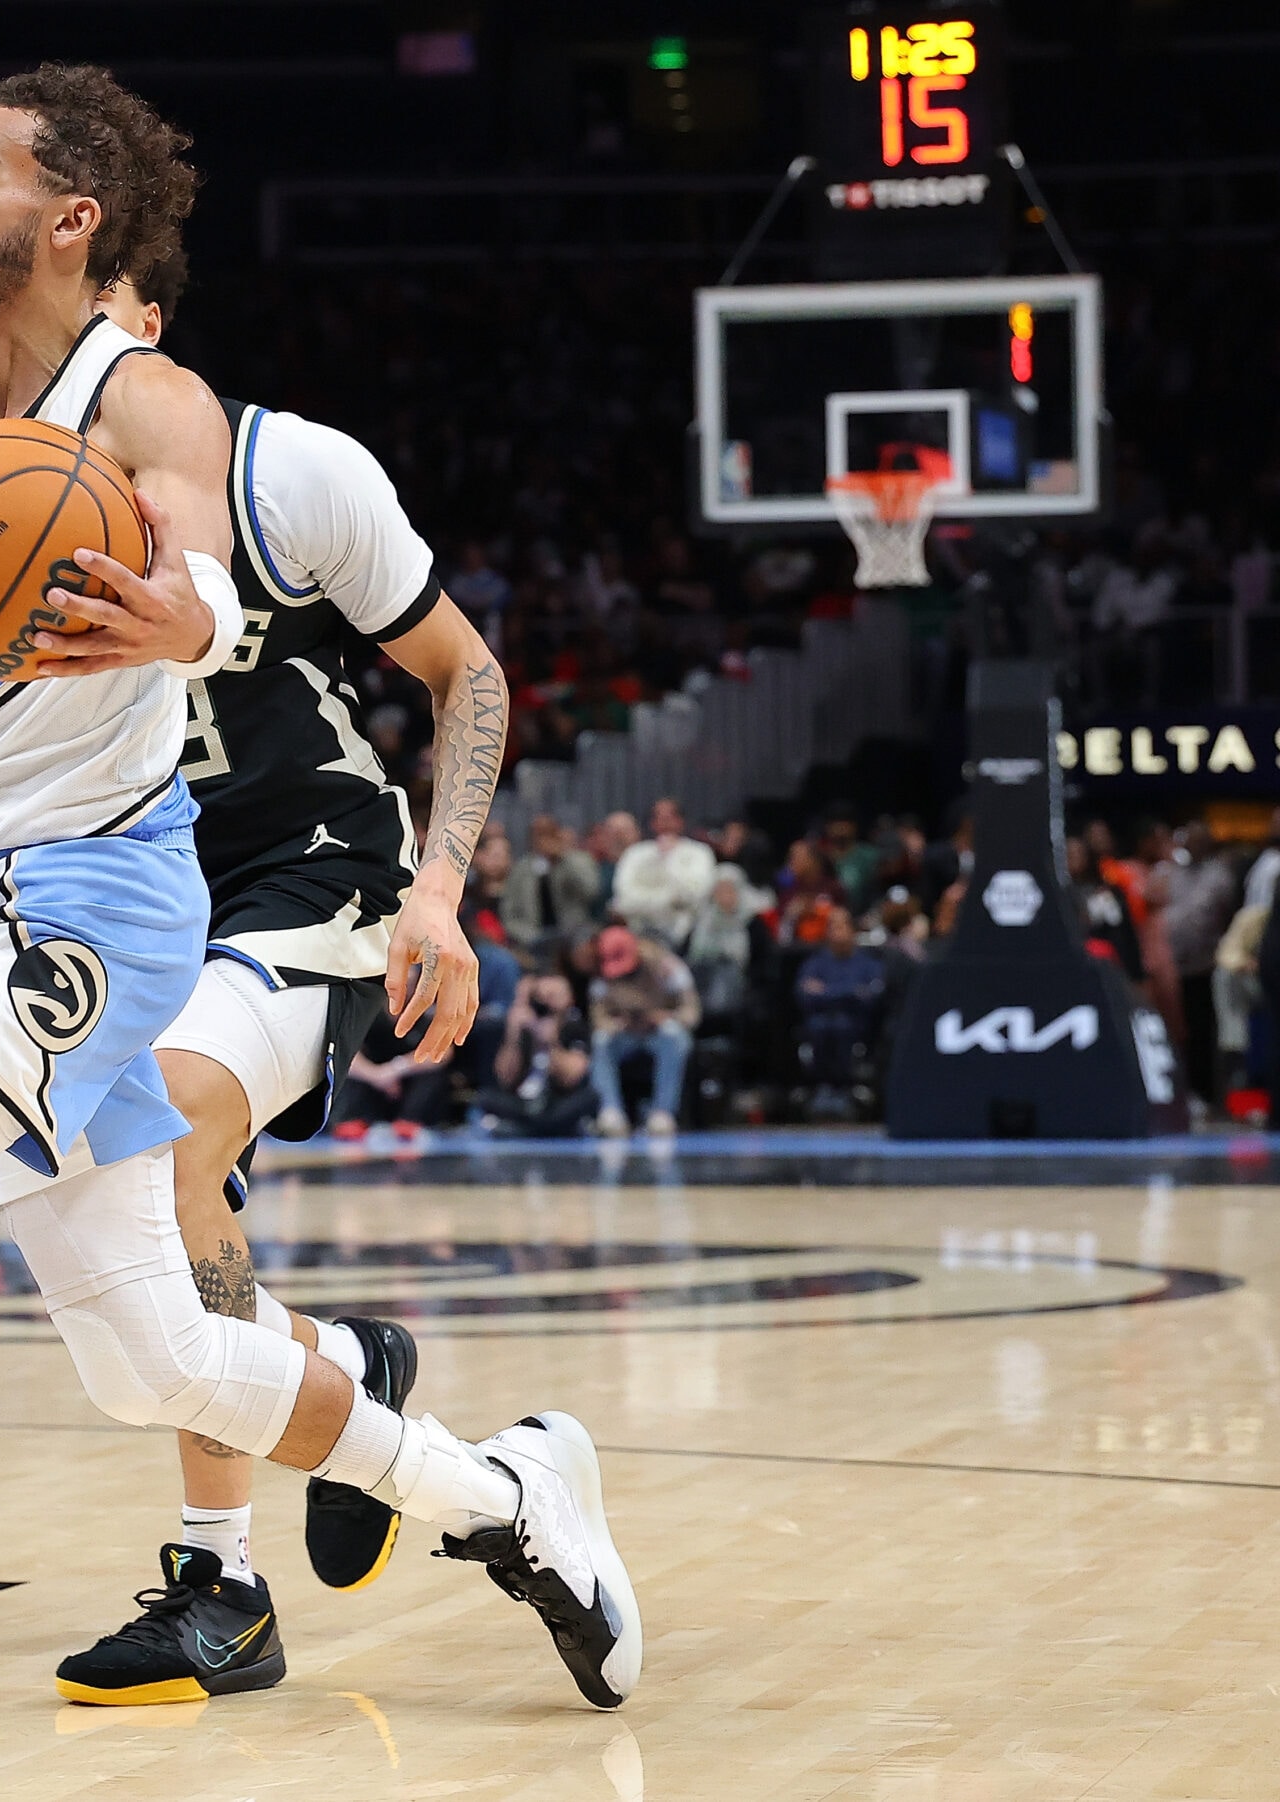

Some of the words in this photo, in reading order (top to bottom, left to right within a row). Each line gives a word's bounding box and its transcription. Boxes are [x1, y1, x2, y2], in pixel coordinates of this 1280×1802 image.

[849, 21, 976, 81] 11:25
[880, 76, 969, 167] 15
[934, 1005, 1099, 1055] KIA
